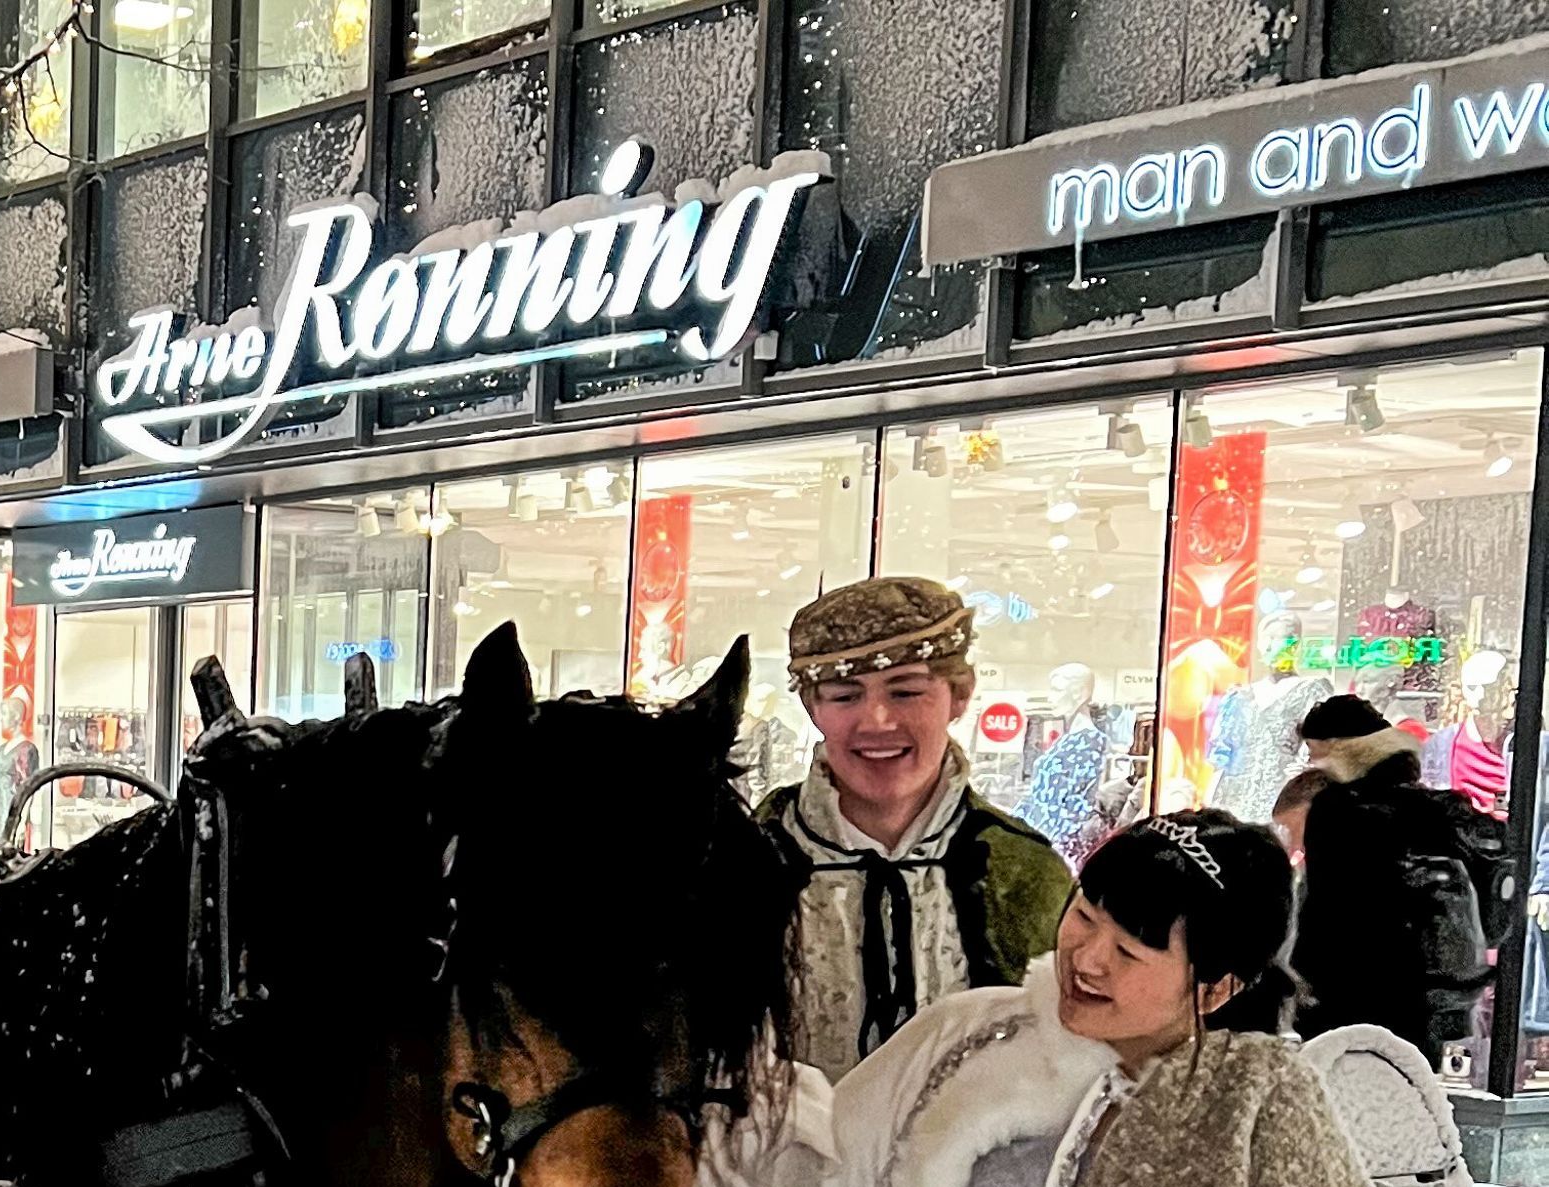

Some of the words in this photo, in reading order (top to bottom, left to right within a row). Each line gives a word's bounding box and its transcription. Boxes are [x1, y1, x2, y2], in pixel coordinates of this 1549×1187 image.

[1047, 142, 1226, 235] man
[1250, 83, 1431, 195] and
[1452, 80, 1549, 160] w
[96, 309, 267, 406] Arne
[250, 140, 820, 400] Rønning
[985, 715, 1018, 731] SALG
